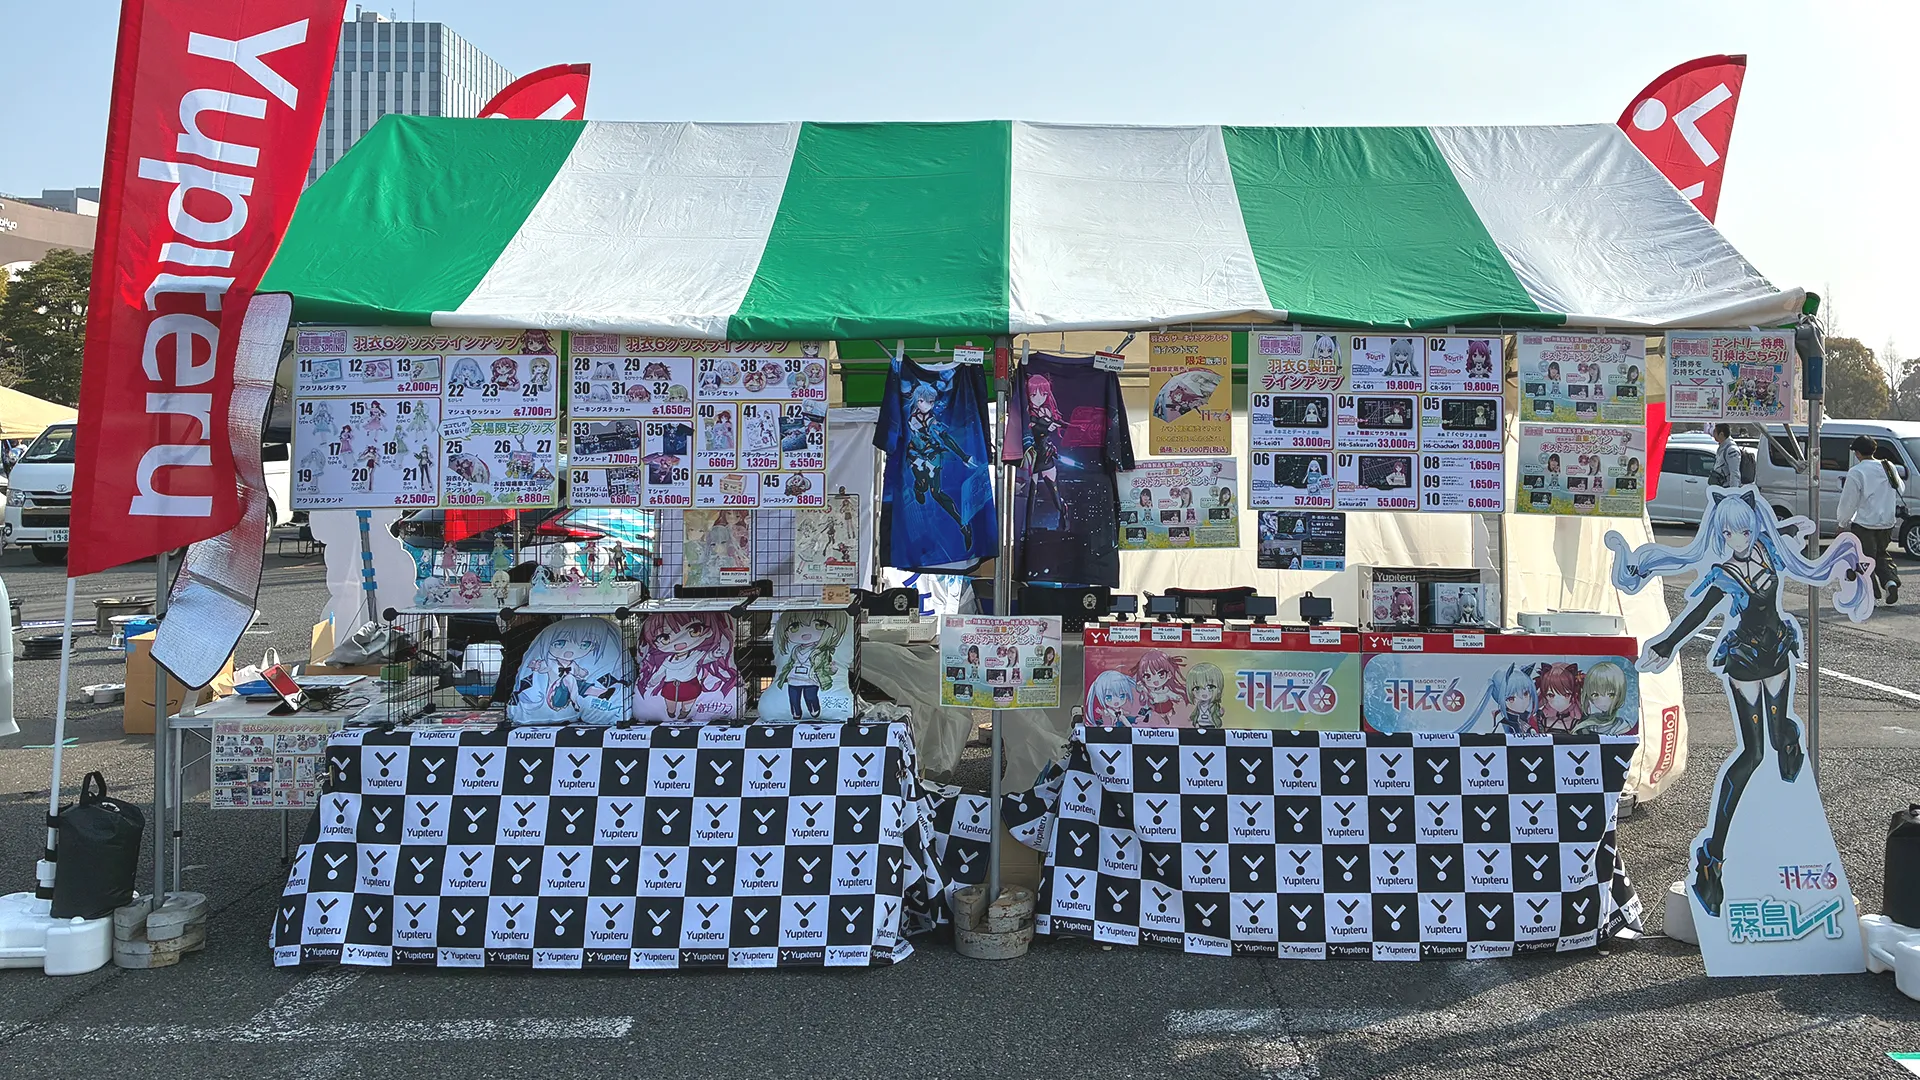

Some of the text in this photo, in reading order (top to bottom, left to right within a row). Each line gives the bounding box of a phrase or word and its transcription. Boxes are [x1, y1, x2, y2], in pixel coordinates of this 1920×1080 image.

[129, 18, 310, 518] Yupiteru
[353, 335, 519, 352] 羽衣6グッズラインアップ
[1353, 337, 1366, 350] 01
[1430, 339, 1446, 351] 02
[1711, 336, 1785, 350] エントリー特典
[1711, 350, 1788, 363] 引換はこちら!!
[299, 359, 312, 373] 11
[349, 359, 362, 372] 12
[397, 359, 410, 372] 13
[574, 358, 590, 370] 28
[624, 358, 640, 371] 29
[700, 359, 715, 372] 37
[741, 359, 757, 371] 38
[785, 359, 801, 372] 39
[1267, 358, 1338, 373] 羽衣6製品
[1673, 360, 1702, 368] 引換券を
[1673, 369, 1725, 377] お持ちください
[397, 382, 438, 393] 各2,000円
[574, 382, 590, 394] 30
[612, 382, 625, 394] 31
[653, 382, 669, 394] 32
[1261, 375, 1345, 391] ラインアップ
[1386, 381, 1423, 391] 19,800円
[1463, 382, 1499, 392] 19,800円
[448, 384, 464, 397] 22
[482, 384, 498, 396] 23
[522, 384, 538, 396] 24
[791, 388, 823, 399] 各880円
[1254, 395, 1269, 407] 03
[1339, 396, 1354, 408] 04
[1423, 397, 1439, 410] 05
[299, 402, 313, 415] 14
[350, 402, 364, 414] 15
[397, 402, 411, 414] 16
[513, 406, 552, 417] 各7,700円
[652, 405, 691, 415] 各1,650円
[698, 405, 714, 417] 40
[743, 405, 757, 417] 41
[786, 405, 802, 418] 42
[471, 421, 556, 435] 会場限定グッズ
[574, 423, 590, 435] 33
[647, 423, 662, 436] 35
[807, 432, 822, 445] 43
[1292, 437, 1331, 448] 33,000円
[1378, 438, 1416, 449] 33,000円
[1462, 439, 1500, 450] 33,000円
[329, 443, 340, 455] 17
[383, 442, 396, 455] 18
[446, 441, 462, 454] 25
[494, 441, 510, 453] 26
[537, 440, 551, 453] 27
[608, 454, 638, 464] 7,700円
[709, 458, 735, 468] 660円
[746, 458, 778, 468] 1,320円
[789, 458, 823, 468] 各550円
[1253, 453, 1269, 466] 06
[1338, 454, 1353, 467] 07
[1424, 456, 1440, 469] 08
[1469, 460, 1500, 471] 1,650円
[297, 469, 311, 482] 19
[351, 469, 368, 481] 20
[403, 468, 416, 481] 21
[573, 471, 589, 484] 34
[673, 468, 689, 480] 36
[697, 475, 713, 487] 44
[764, 475, 779, 487] 45
[1424, 474, 1440, 487] 09
[1469, 479, 1500, 489] 1,650円
[395, 494, 436, 505] 各2,500円
[447, 494, 485, 505] 15,000円
[516, 494, 550, 504] 各880円
[610, 494, 637, 504] 6,600円
[649, 494, 690, 505] 各6,600円
[723, 494, 756, 504] 2,200円
[797, 494, 823, 504] 880円
[1294, 496, 1331, 506] 57,200円
[1377, 497, 1416, 508] 55,000円
[1425, 493, 1439, 505] 10
[1468, 498, 1500, 508] 6,600円
[1376, 572, 1416, 583] Yupiteru
[1237, 670, 1337, 713] 羽衣6
[1386, 677, 1465, 712] 羽衣6
[799, 730, 835, 742] Yupiteru
[1661, 710, 1676, 769] Coleman
[367, 778, 403, 789] Yupiteru
[1468, 778, 1504, 788] Yupiteru
[407, 828, 443, 839] Yupiteru
[600, 829, 638, 840] Yupiteru
[1234, 827, 1270, 837] Yupiteru
[1283, 876, 1320, 886] Yupiteru
[1377, 876, 1414, 886] Yupiteru
[1778, 862, 1838, 890] 羽衣6
[741, 878, 778, 890] Yupiteru
[1729, 899, 1840, 938] 霧島レイ
[307, 926, 341, 936] Yupiteru
[1061, 921, 1092, 931] Yupiteru
[785, 929, 823, 940] Yupiteru
[1291, 946, 1322, 954] Yupiteru
[1339, 946, 1370, 955] Yupiteru
[1525, 943, 1555, 951] Yupiteru
[357, 949, 389, 958] Yupiteru
[547, 952, 579, 962] Yupiteru
[789, 950, 823, 960] Yupiteru
